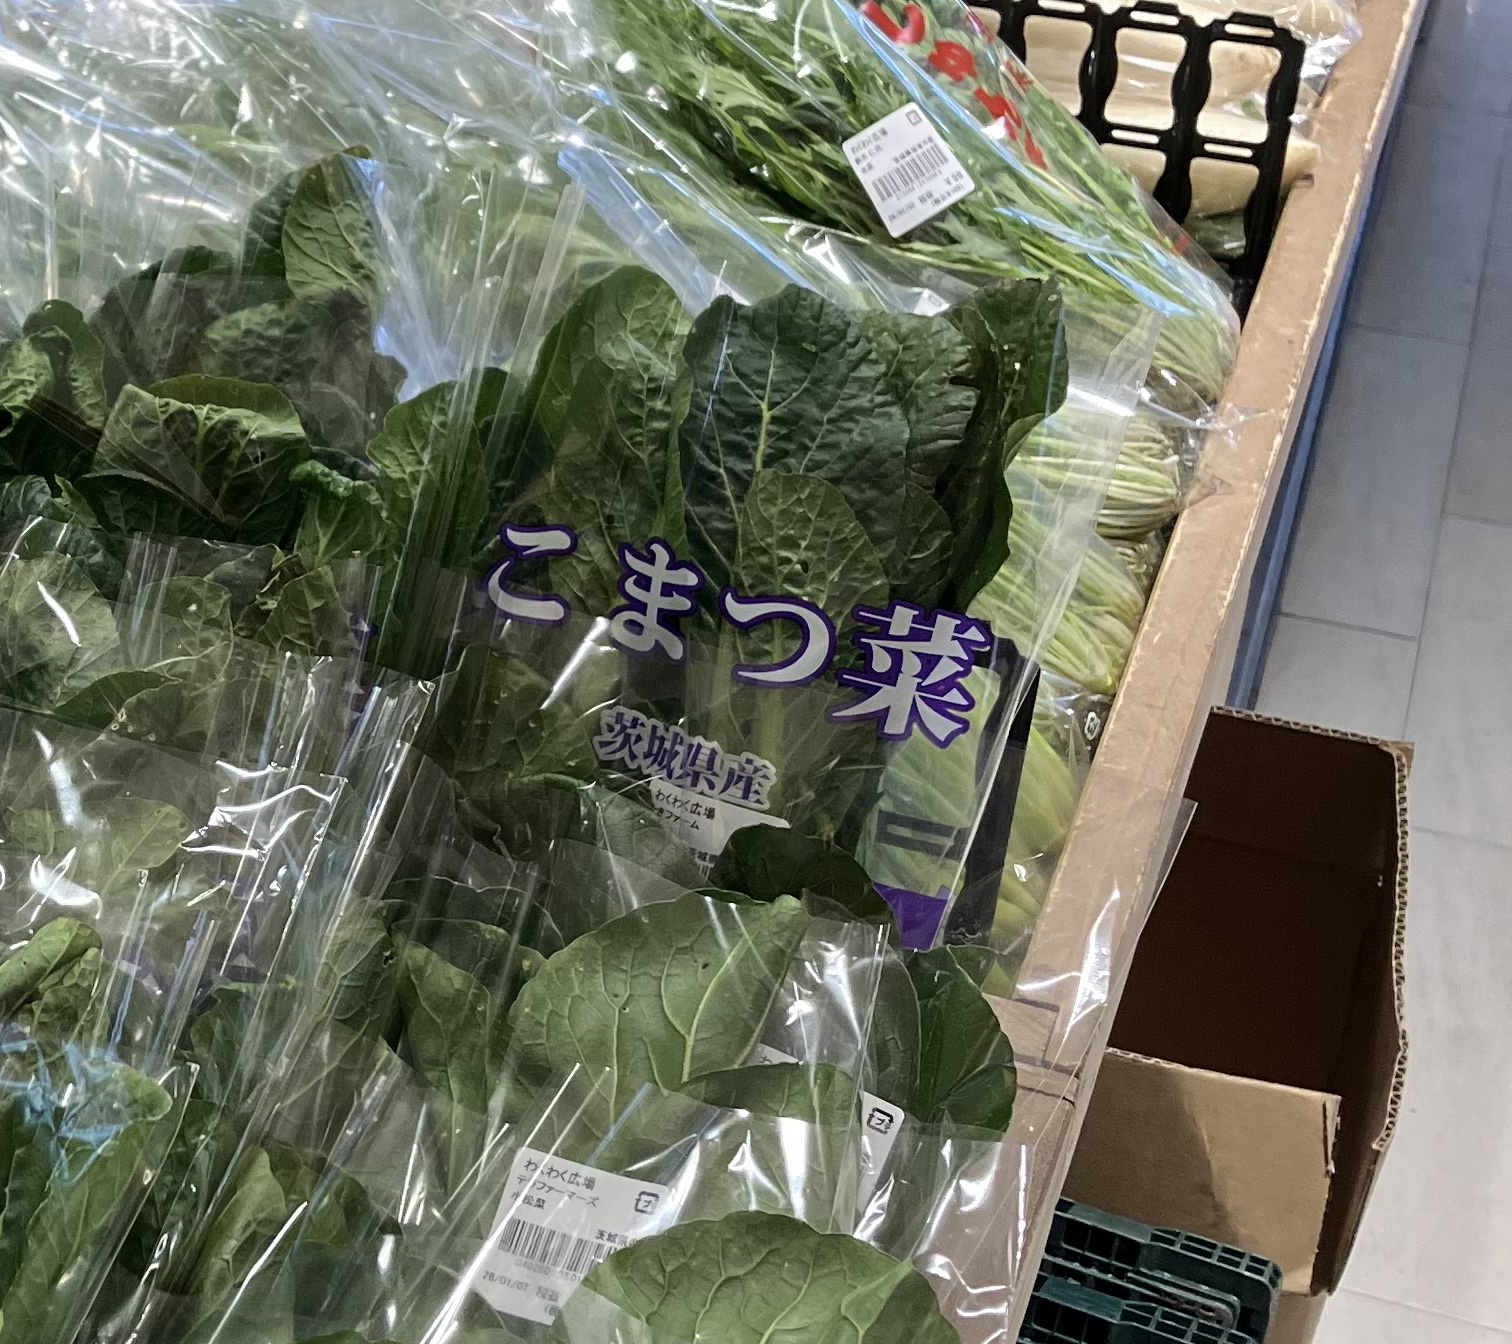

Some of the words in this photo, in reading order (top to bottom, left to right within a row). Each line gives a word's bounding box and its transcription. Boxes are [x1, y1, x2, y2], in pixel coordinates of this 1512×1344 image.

[486, 524, 991, 747] こまつ菜
[595, 710, 774, 808] 茨城県産
